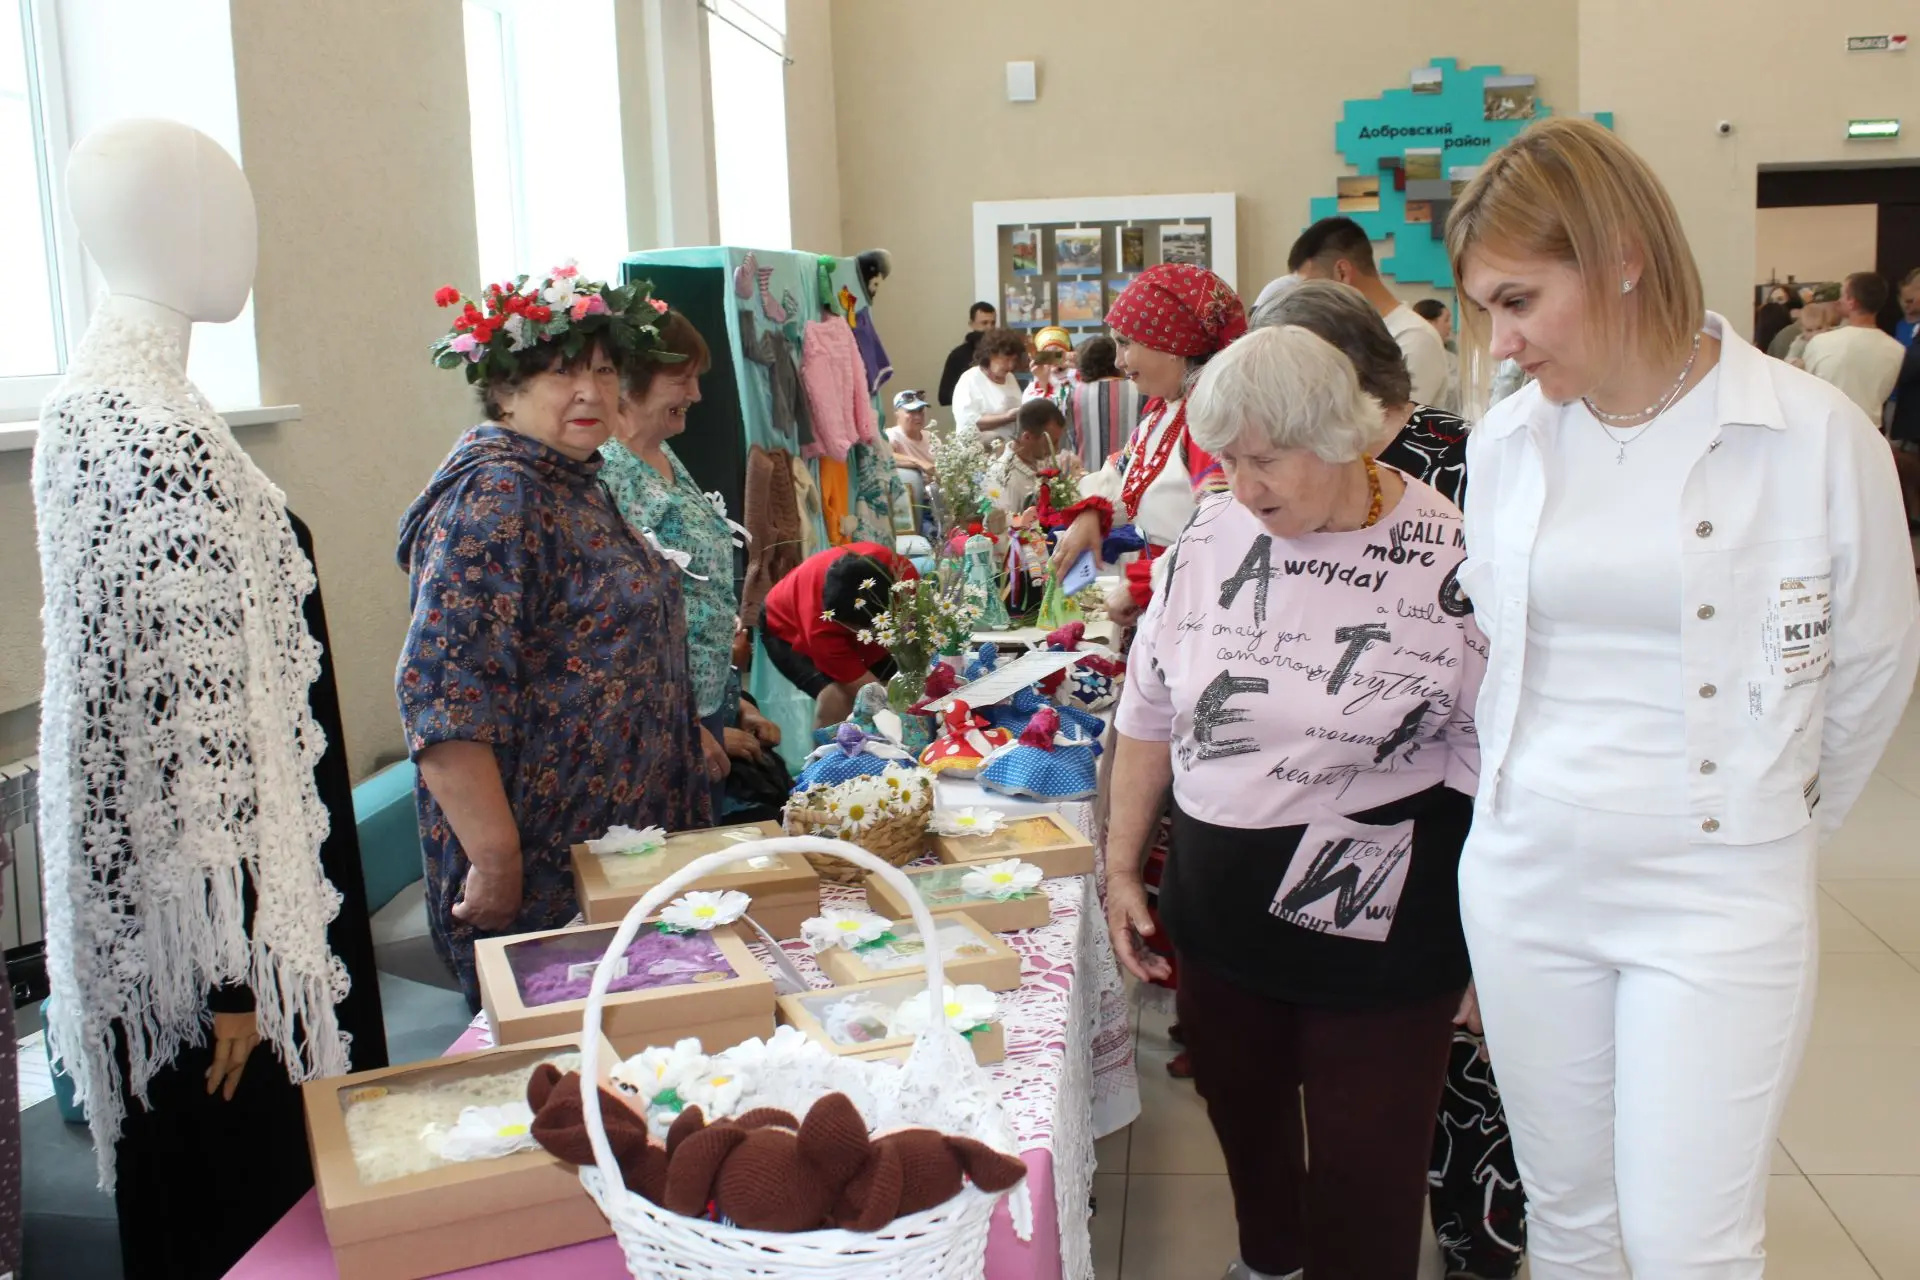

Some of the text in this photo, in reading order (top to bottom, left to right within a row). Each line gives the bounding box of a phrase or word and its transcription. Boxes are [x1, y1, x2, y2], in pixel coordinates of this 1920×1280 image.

[1359, 122, 1453, 140] Добровский
[1443, 134, 1491, 150] район
[1401, 520, 1467, 551] CALL M
[1397, 598, 1447, 624] little
